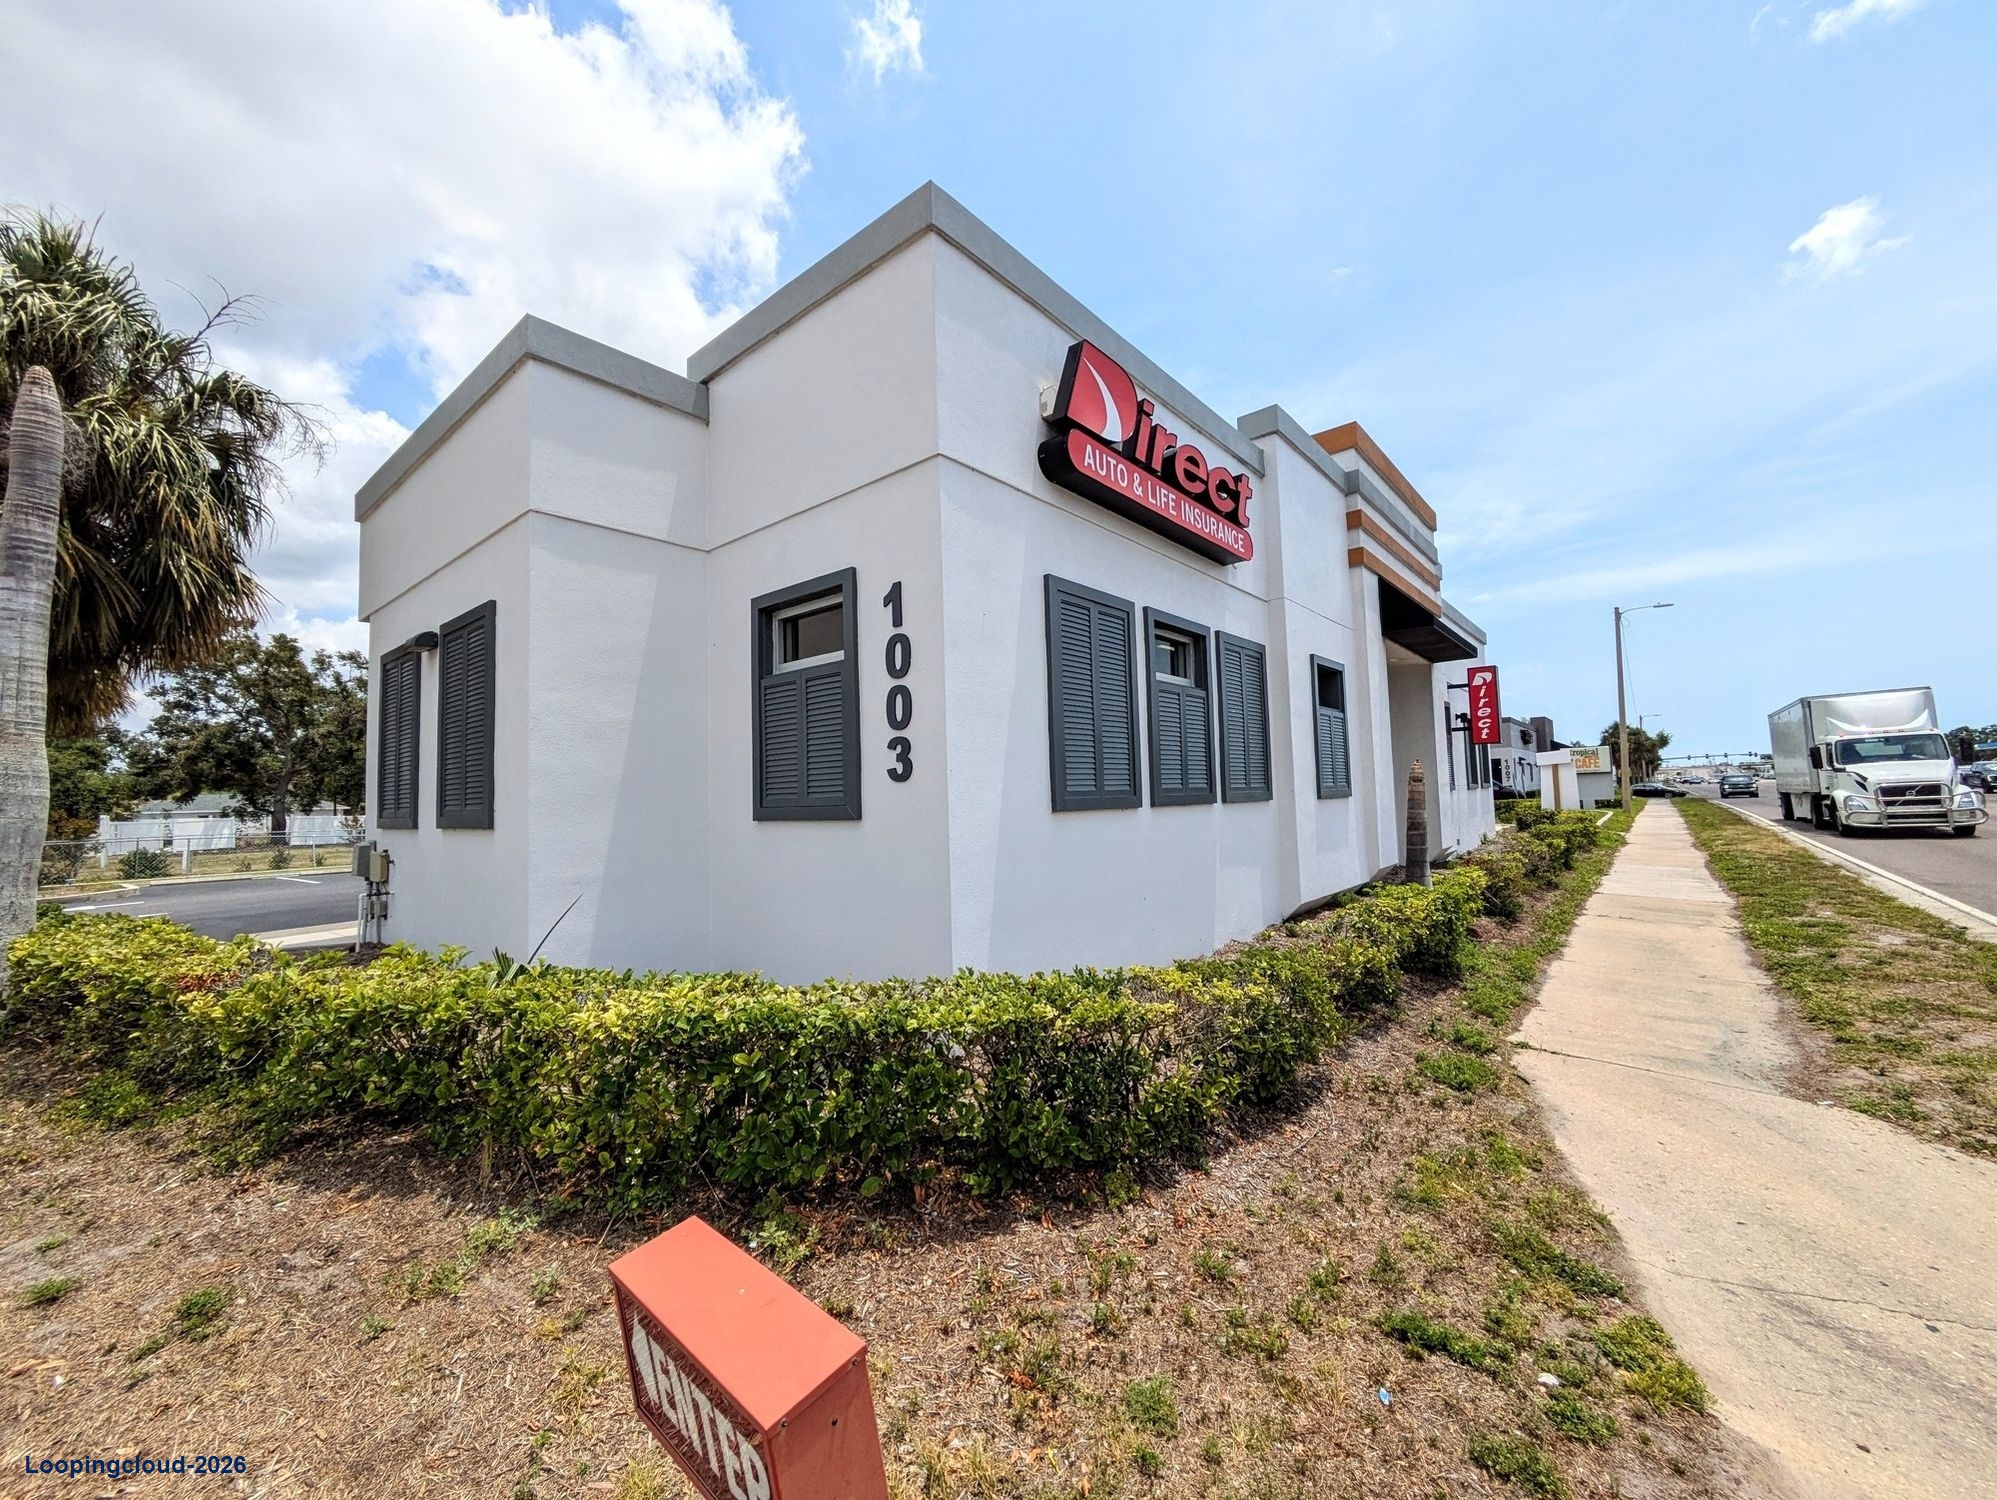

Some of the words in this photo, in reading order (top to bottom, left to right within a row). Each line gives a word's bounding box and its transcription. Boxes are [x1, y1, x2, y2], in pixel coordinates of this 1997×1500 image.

[1067, 340, 1253, 527] Direct
[1083, 444, 1128, 486] AUTO
[1132, 472, 1143, 498] &
[1147, 479, 1176, 516] LIFE
[1180, 500, 1245, 553] INSURANCE
[883, 580, 913, 783] 1003
[1471, 671, 1493, 739] Direct
